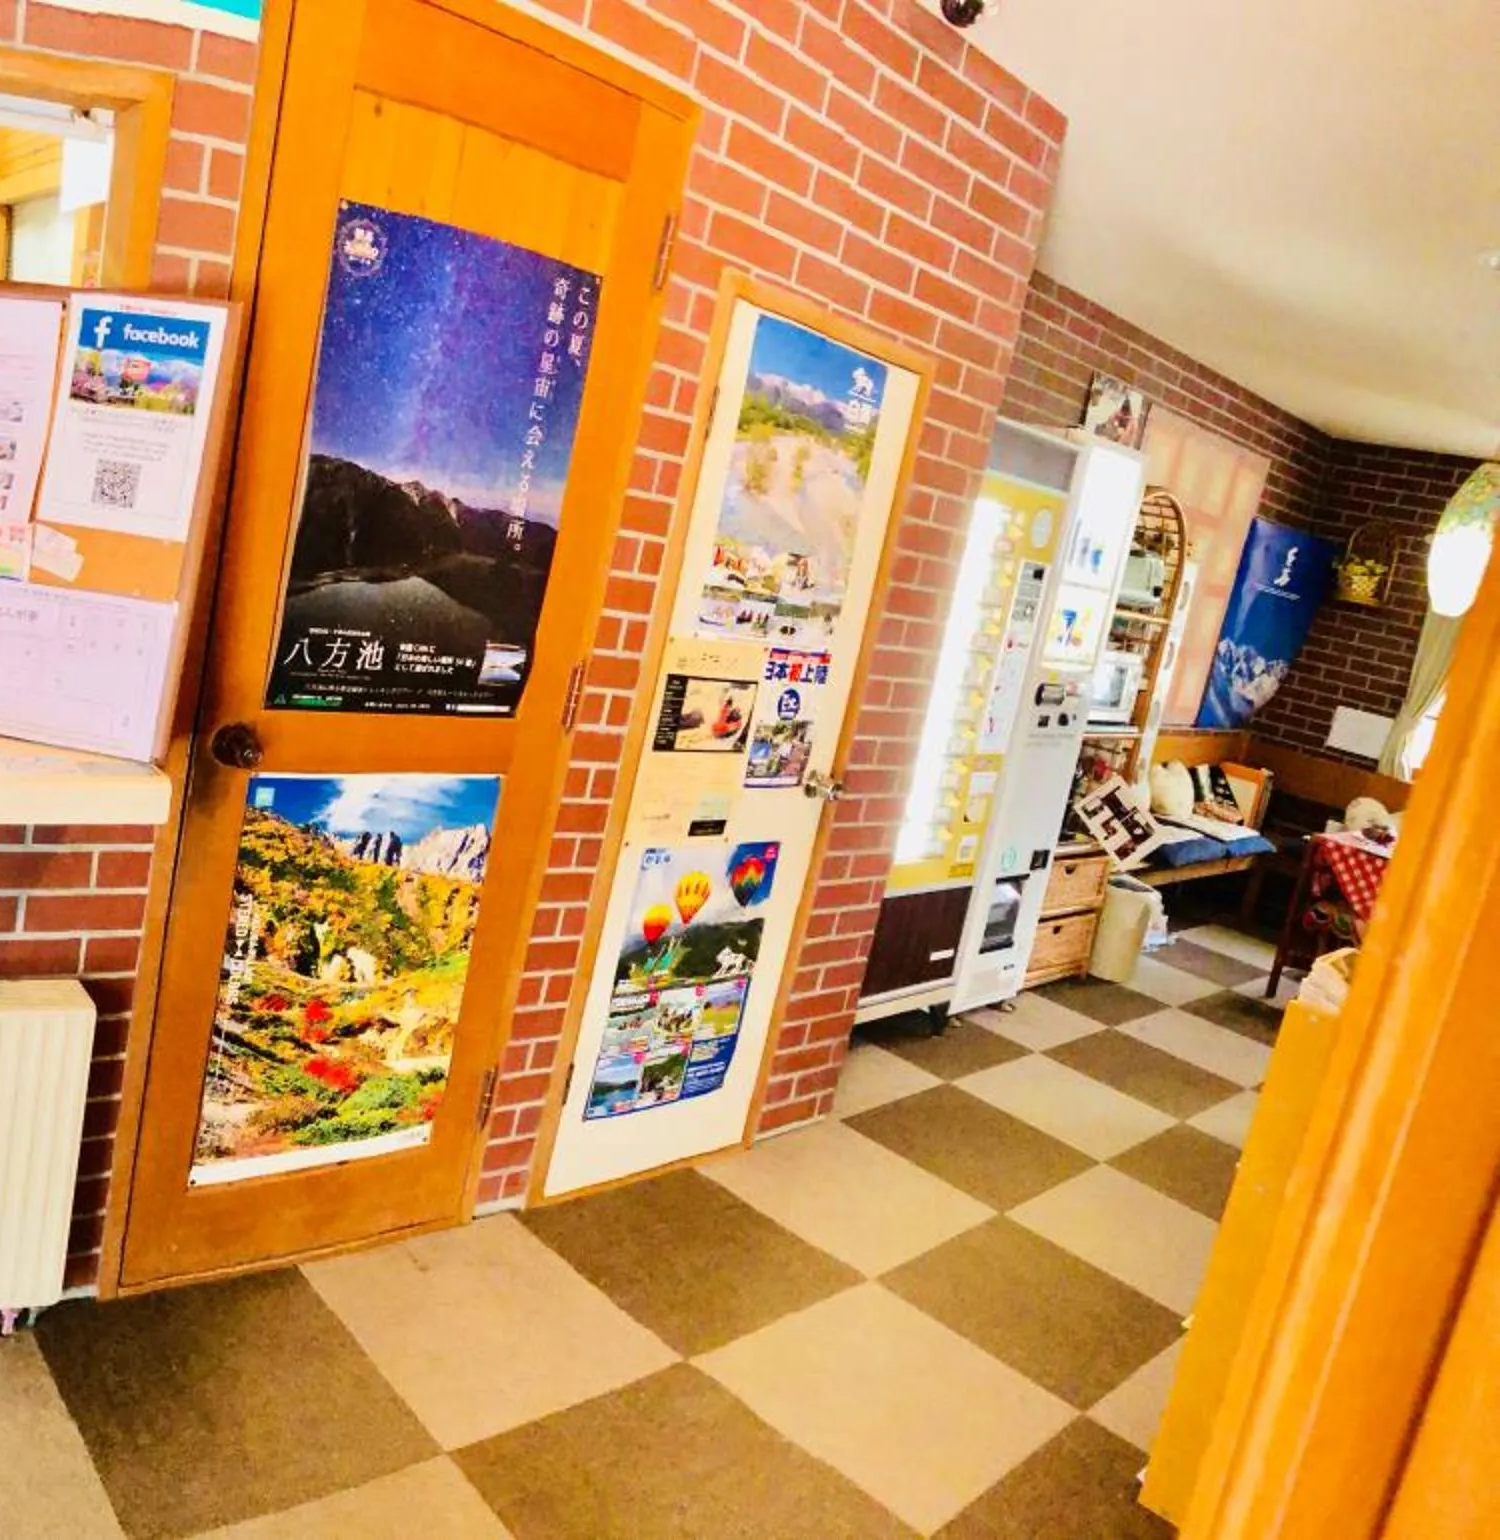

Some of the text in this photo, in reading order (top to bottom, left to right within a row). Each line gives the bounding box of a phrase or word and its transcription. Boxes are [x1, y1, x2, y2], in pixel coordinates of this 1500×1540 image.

[123, 322, 200, 350] facebook
[284, 636, 385, 671] 八方池
